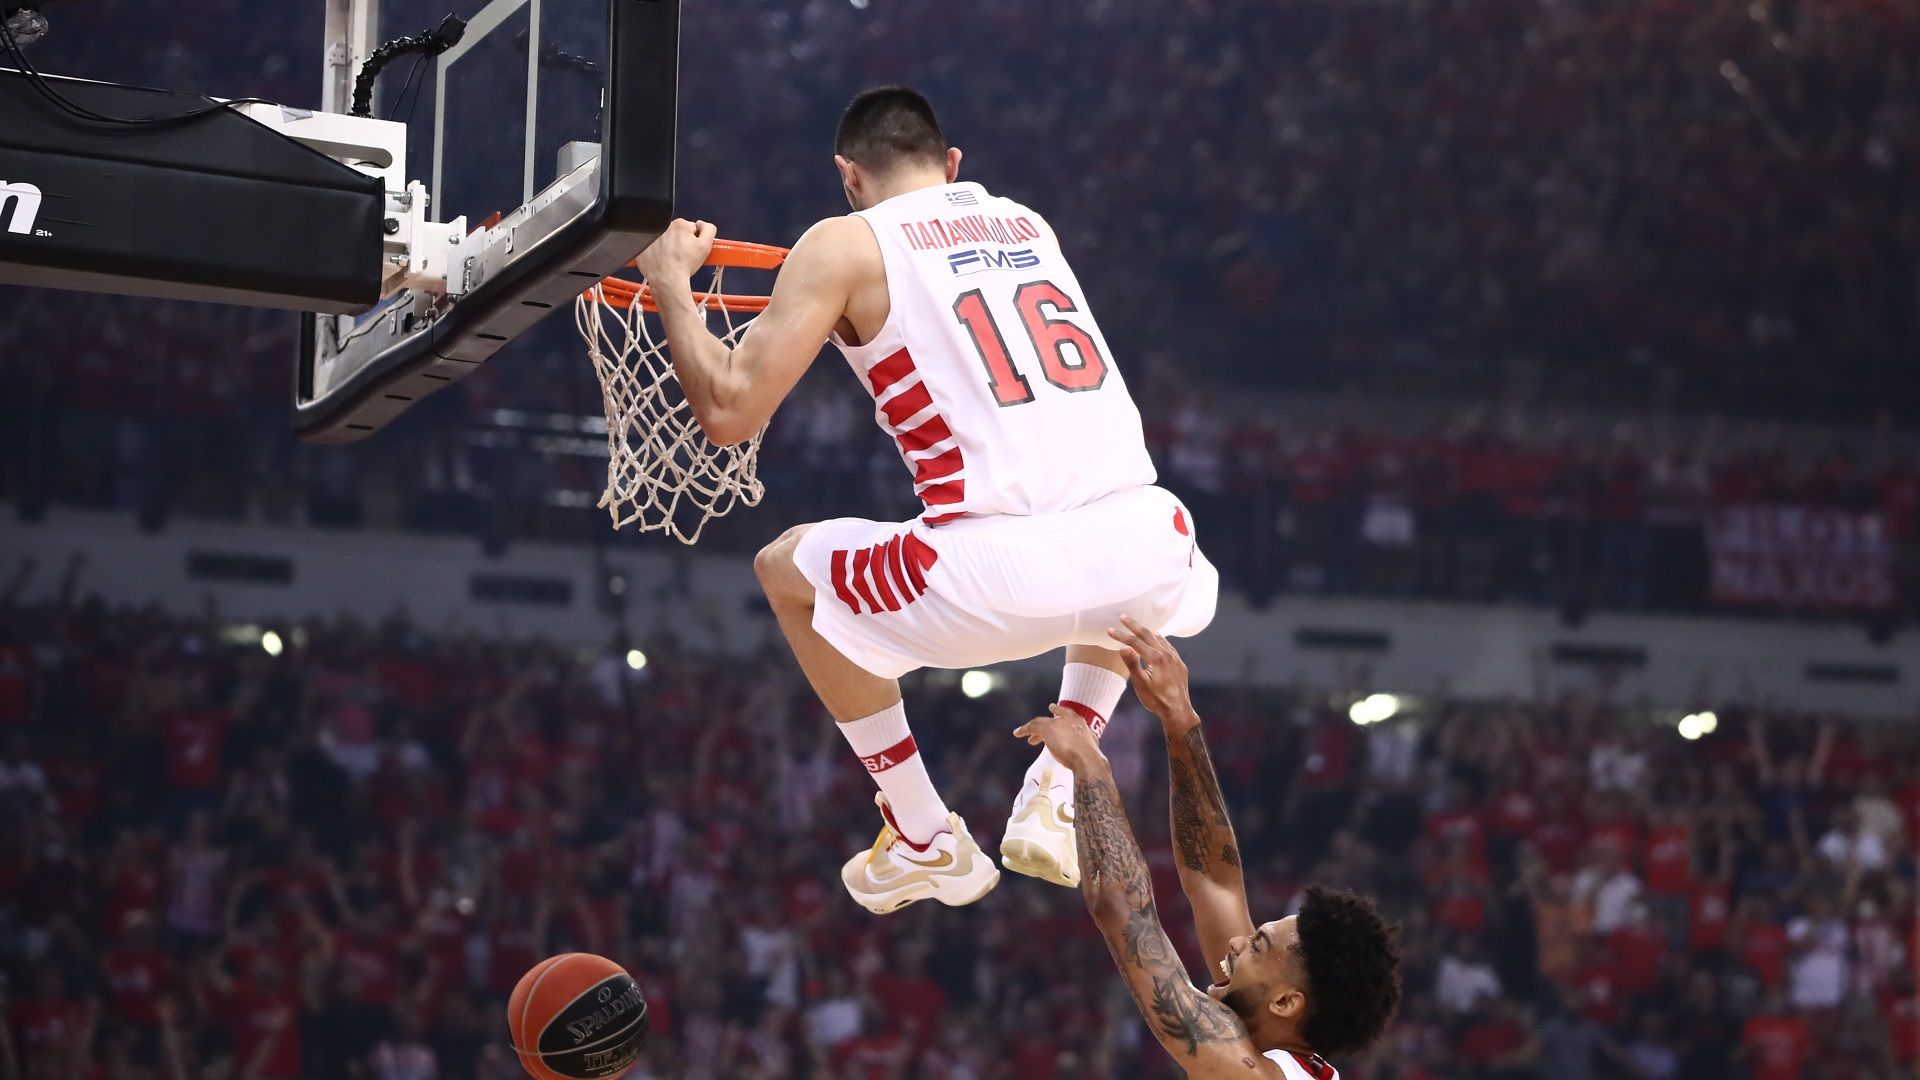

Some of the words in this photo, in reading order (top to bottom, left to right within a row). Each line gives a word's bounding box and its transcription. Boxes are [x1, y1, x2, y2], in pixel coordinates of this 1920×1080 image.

[35, 229, 53, 237] 21+
[947, 248, 1041, 275] FMS
[952, 280, 1109, 408] 16
[860, 754, 895, 772] SA
